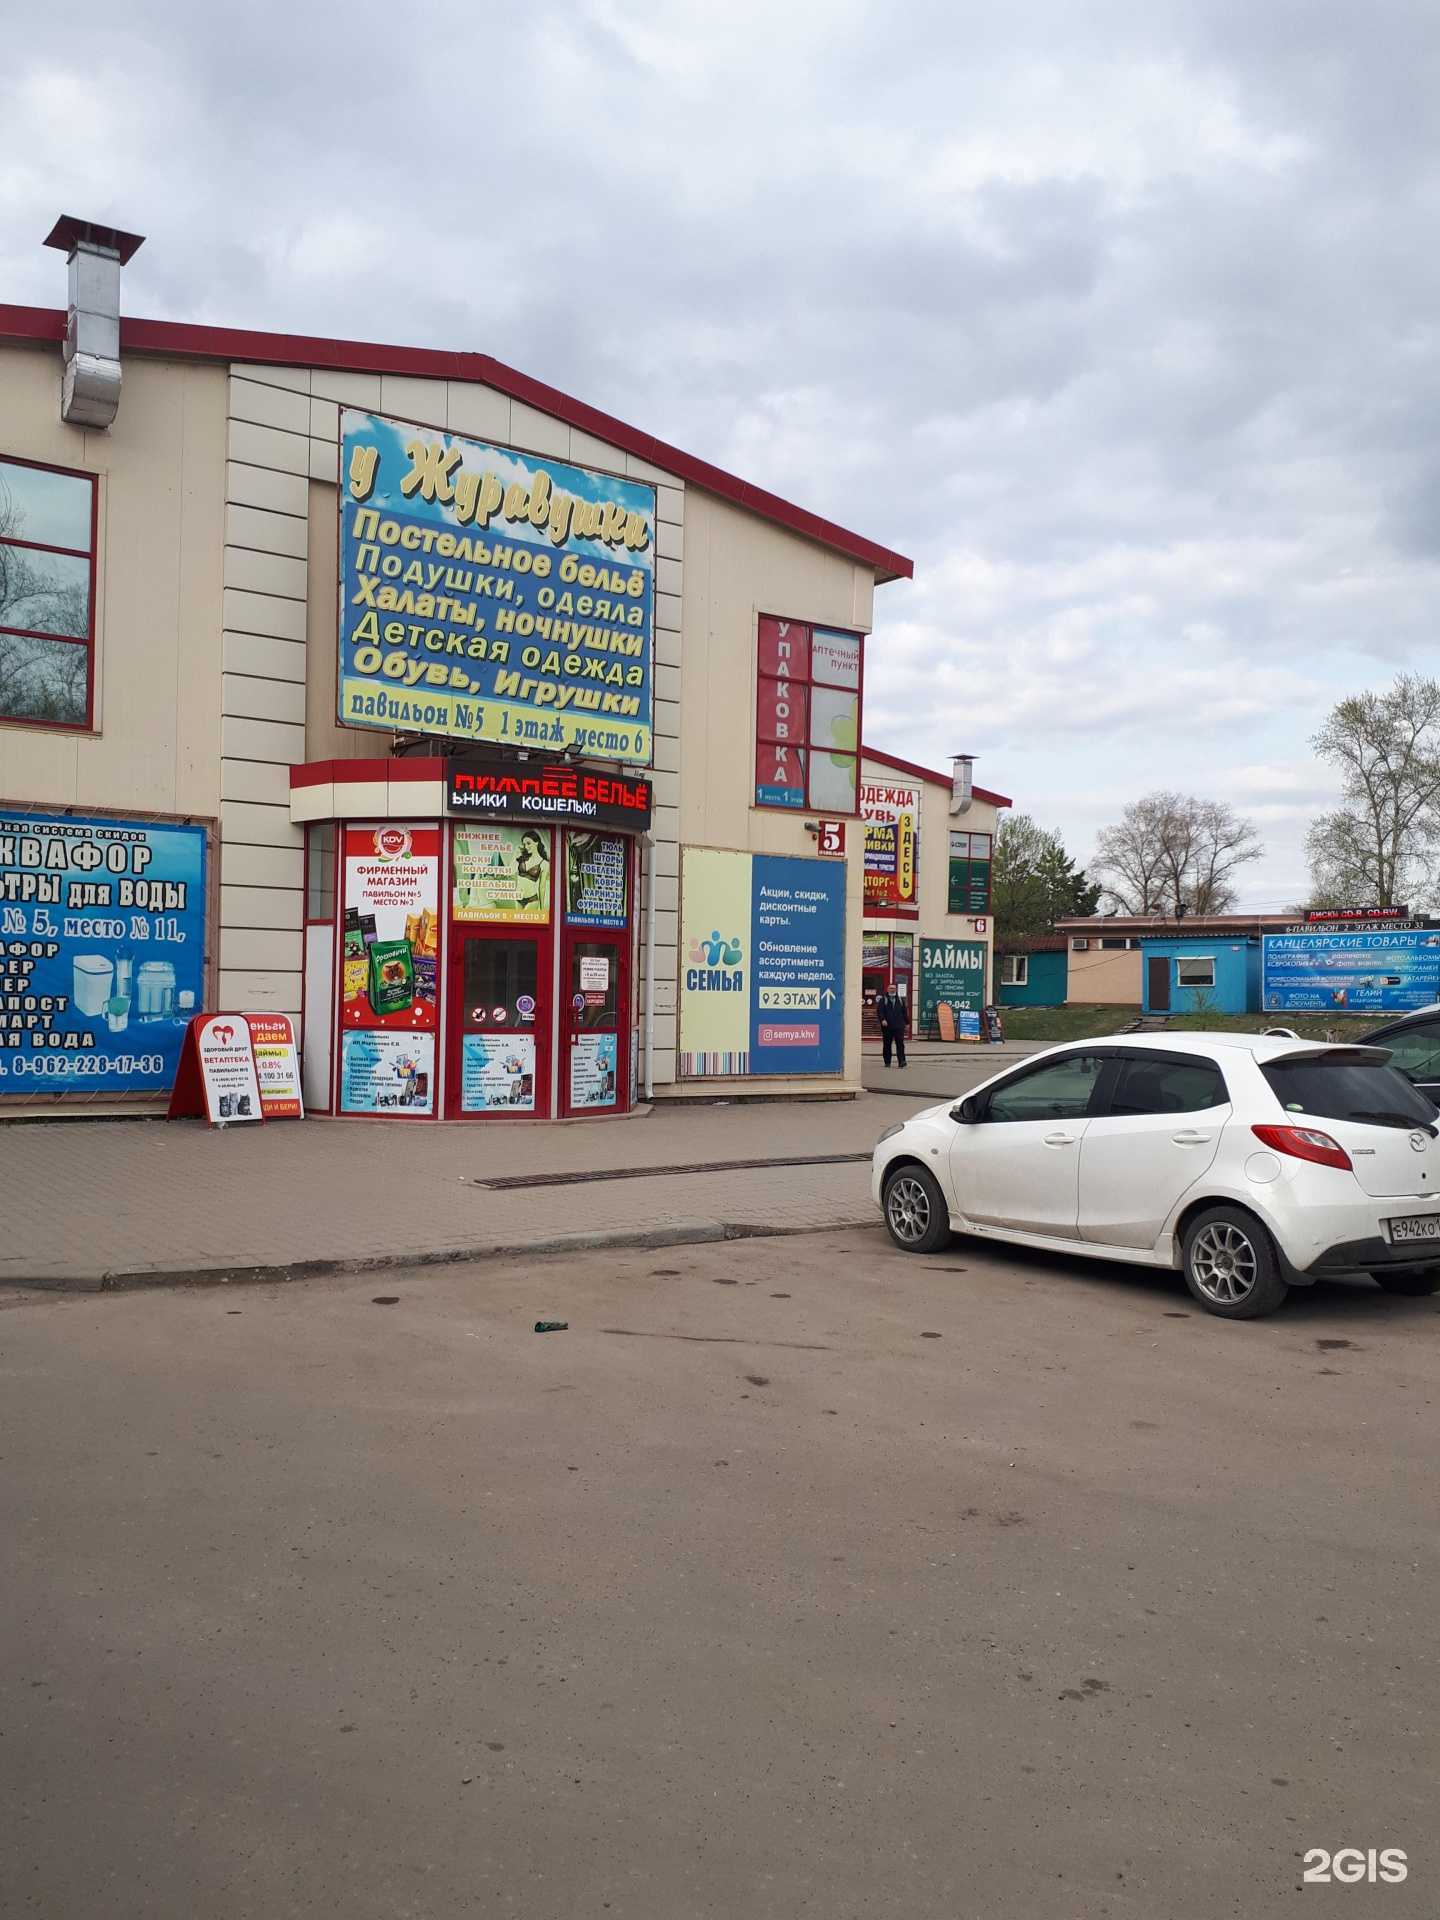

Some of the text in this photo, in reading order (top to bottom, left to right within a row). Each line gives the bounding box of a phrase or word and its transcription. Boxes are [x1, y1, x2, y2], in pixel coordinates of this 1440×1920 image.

[401, 440, 649, 550] Журавушки
[352, 507, 645, 598] Постельное бельё
[355, 543, 644, 627] Подушки, одеяла
[351, 574, 644, 657] Халаты, ночнушки
[351, 611, 645, 687] Детская одежда
[353, 646, 641, 716] Обувь, Игрушки
[773, 621, 791, 783] УПАКОВКА
[351, 692, 643, 753] павильон №5 1 этаж место 6
[583, 776, 648, 811] БЕЛЬЁ
[522, 796, 597, 815] КОШЕЛЬКИ
[0, 822, 146, 841] кая система скидок
[457, 832, 500, 841] НИЖНЕЕ
[823, 823, 840, 850] 5
[602, 842, 624, 852] ТЮЛЬ
[457, 855, 491, 863] НОСКИ
[593, 853, 623, 864] ШТОРЫ
[357, 863, 428, 875] ФИРМЕННЫЙ
[581, 864, 623, 876] ГОБЕЛЕНЫ
[367, 877, 417, 886] МАГАЗИН
[595, 877, 623, 888] КОВРЫ
[68, 883, 111, 908] для
[119, 880, 187, 911] ВОДЫ
[362, 890, 406, 898] ПАВИЛЬОН
[760, 886, 830, 901] Акции, скидки,
[759, 902, 817, 914] дисконтные
[2, 908, 26, 934] №
[33, 909, 58, 936] 5,
[64, 918, 125, 939] место
[130, 916, 149, 939] №
[759, 915, 791, 927] карты.
[976, 919, 985, 932] 6
[1356, 923, 1380, 931] ЭТАЖ
[1381, 922, 1411, 930] МЕСТО
[759, 941, 818, 953] Обновление
[1269, 936, 1418, 949] КАНЦЕЛЯРСКИЕ ТОВАРЫ
[758, 957, 825, 969] ассортимента
[922, 944, 983, 969] ЗАЙМЫ
[686, 969, 743, 992] СЕМЬЯ
[758, 970, 836, 983] каждую неделю.
[0, 978, 29, 992] ЕР
[773, 992, 817, 1006] 2 ЭТАЖ
[32, 1033, 94, 1048] ВОДА
[773, 1030, 815, 1041] semya.khv
[13, 1055, 163, 1075] 8-962-228-17-36
